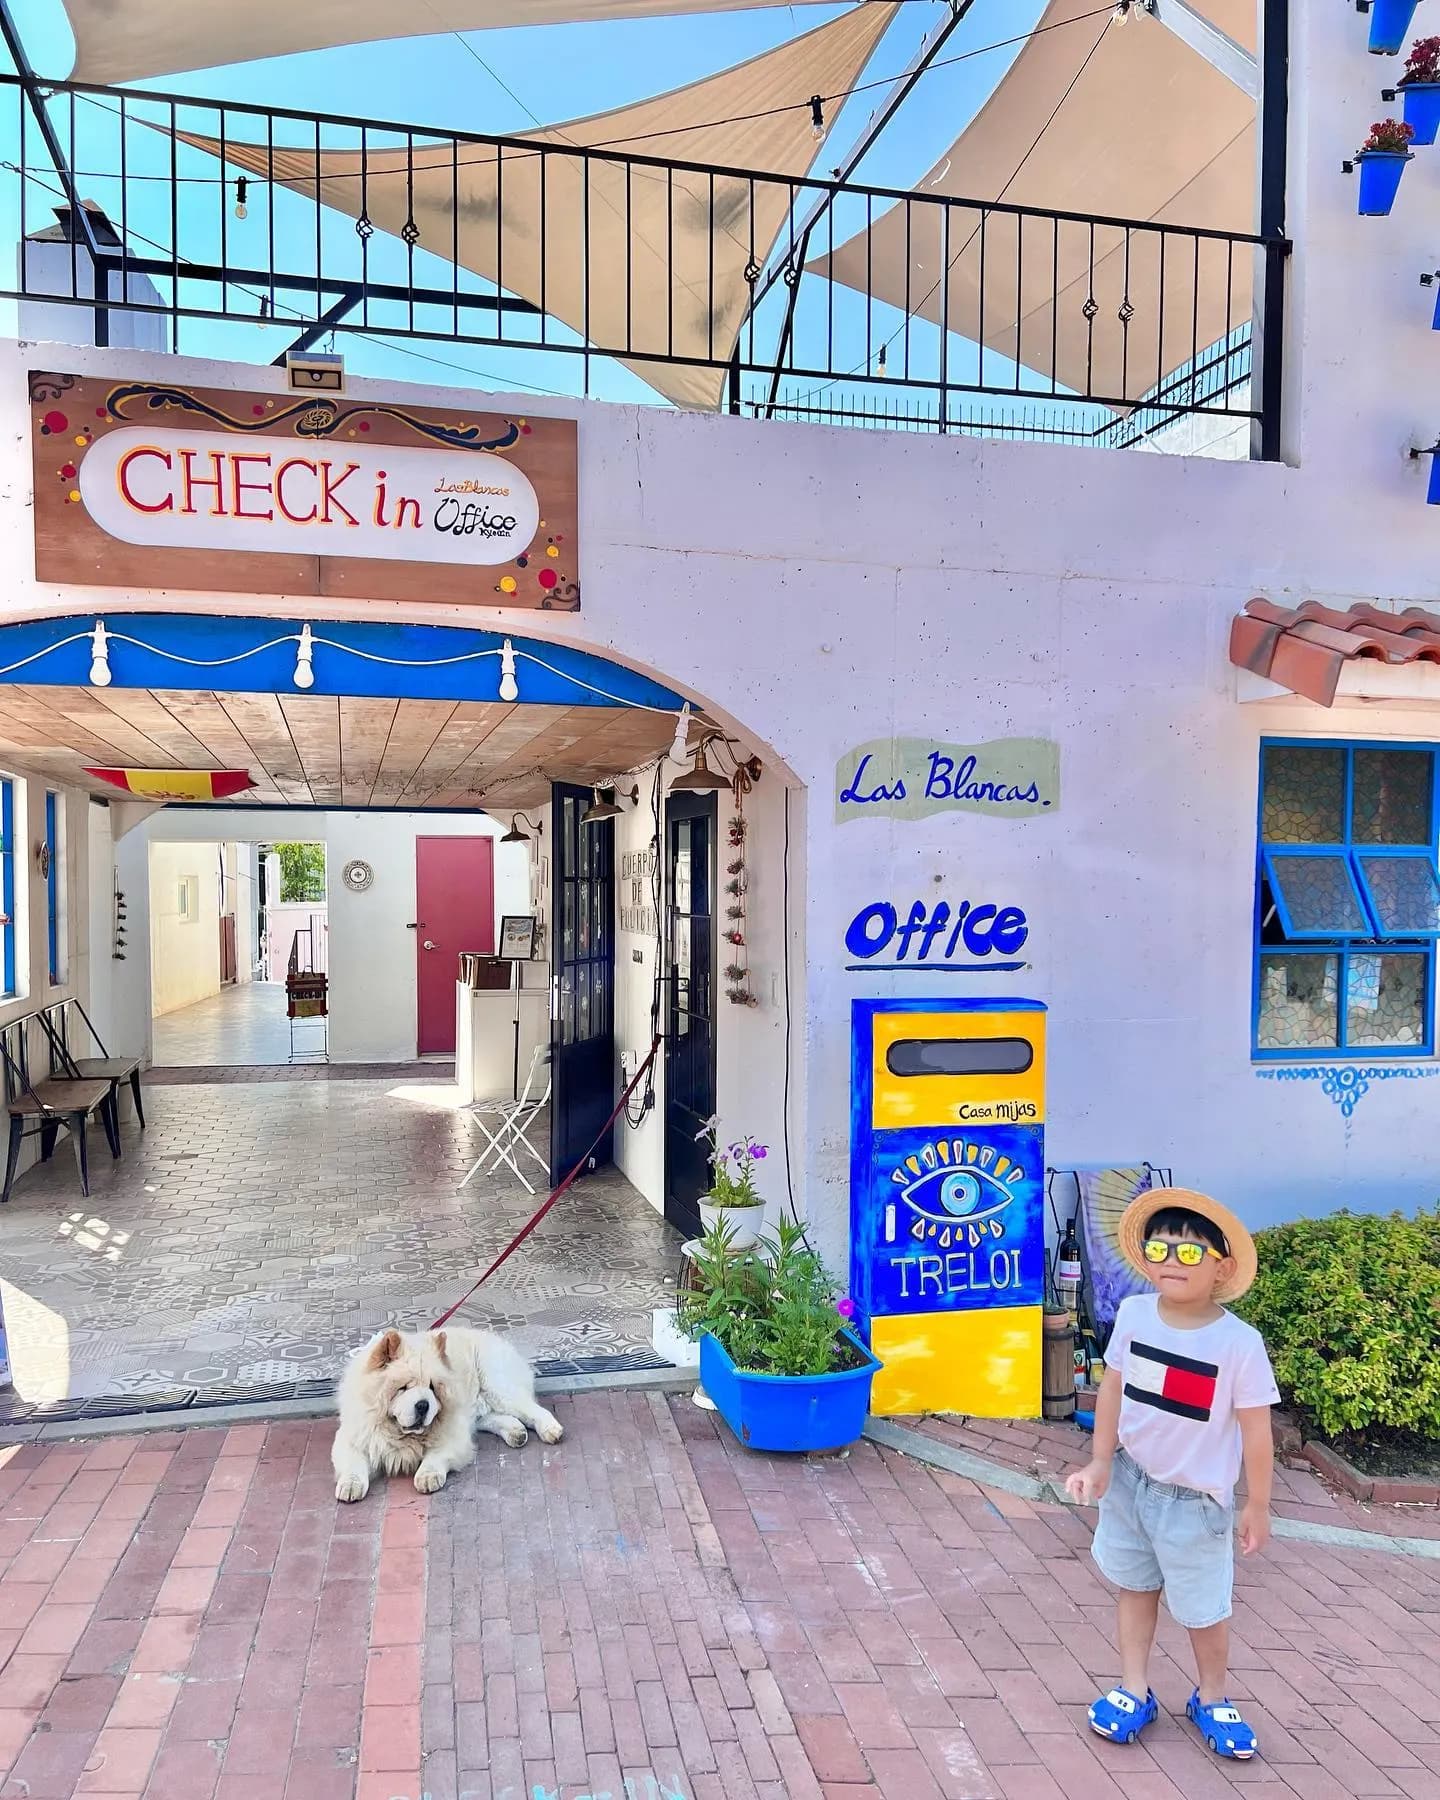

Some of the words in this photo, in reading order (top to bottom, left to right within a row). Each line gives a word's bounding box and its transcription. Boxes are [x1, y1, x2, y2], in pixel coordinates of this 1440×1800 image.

[117, 445, 360, 527] CHECK
[374, 470, 424, 528] in
[434, 497, 518, 535] Office
[840, 754, 906, 803] Las
[632, 881, 642, 903] DE
[845, 900, 1028, 960] Office
[959, 1104, 992, 1119] Casa
[890, 1250, 1022, 1297] TRELOI
